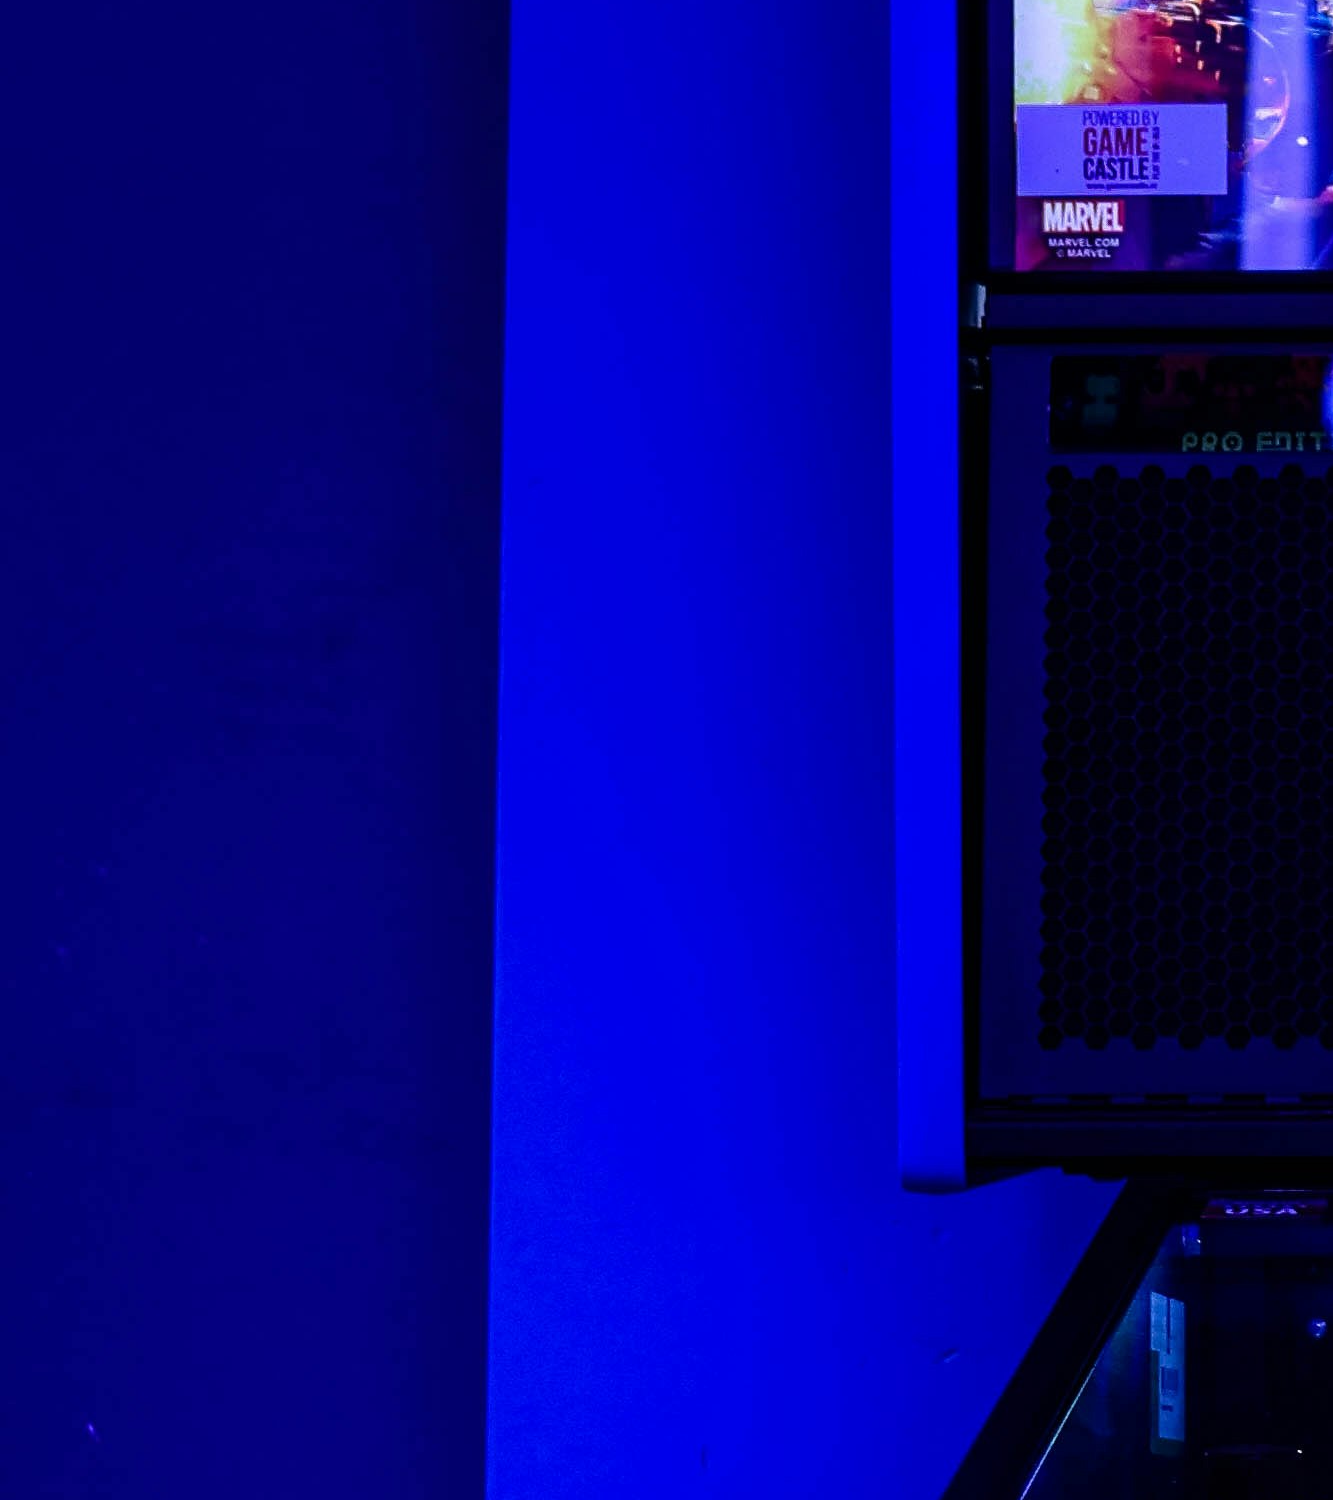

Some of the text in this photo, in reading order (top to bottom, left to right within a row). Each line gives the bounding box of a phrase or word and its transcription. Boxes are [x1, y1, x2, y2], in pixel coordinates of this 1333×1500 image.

[1083, 110, 1160, 126] POWERED BY
[1083, 127, 1149, 156] GAME
[1083, 157, 1149, 181] CASTLE
[1043, 202, 1124, 232] MARVEL
[1066, 248, 1111, 258] MARVEL
[1181, 431, 1243, 453] PRO
